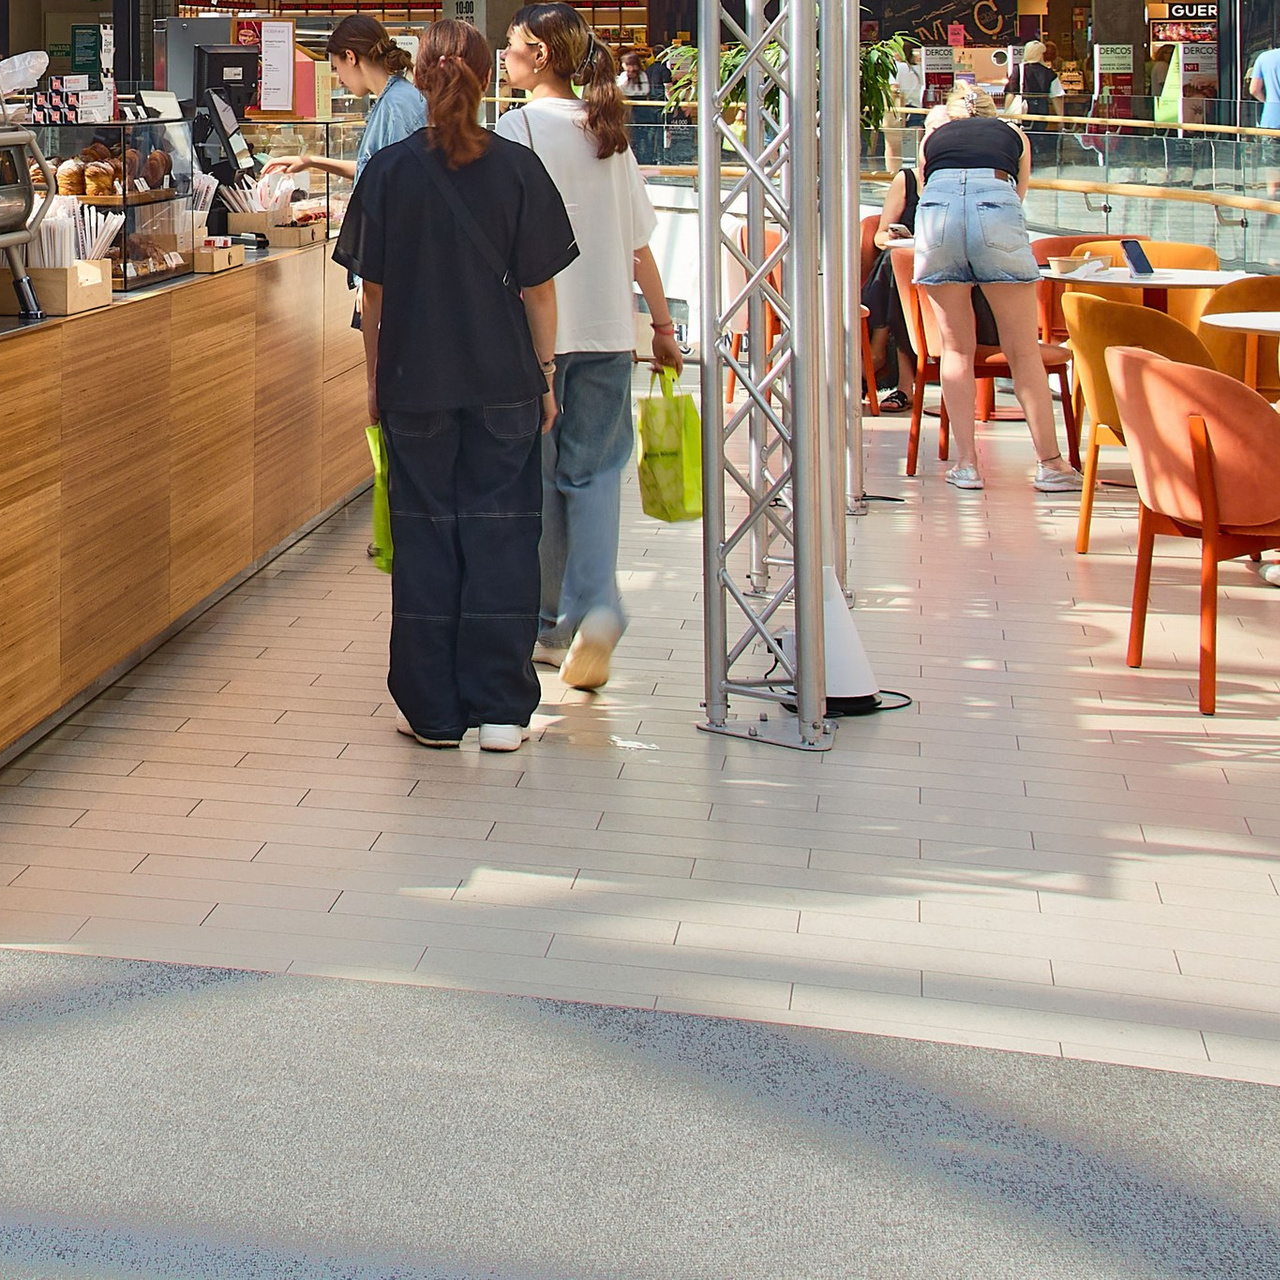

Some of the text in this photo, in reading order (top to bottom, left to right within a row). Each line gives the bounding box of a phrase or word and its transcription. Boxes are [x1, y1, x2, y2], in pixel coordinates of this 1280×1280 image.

[455, 1, 475, 15] 10:00
[1171, 4, 1217, 17] GUER
[925, 48, 953, 57] DERCOS
[1100, 46, 1132, 55] DERCOS
